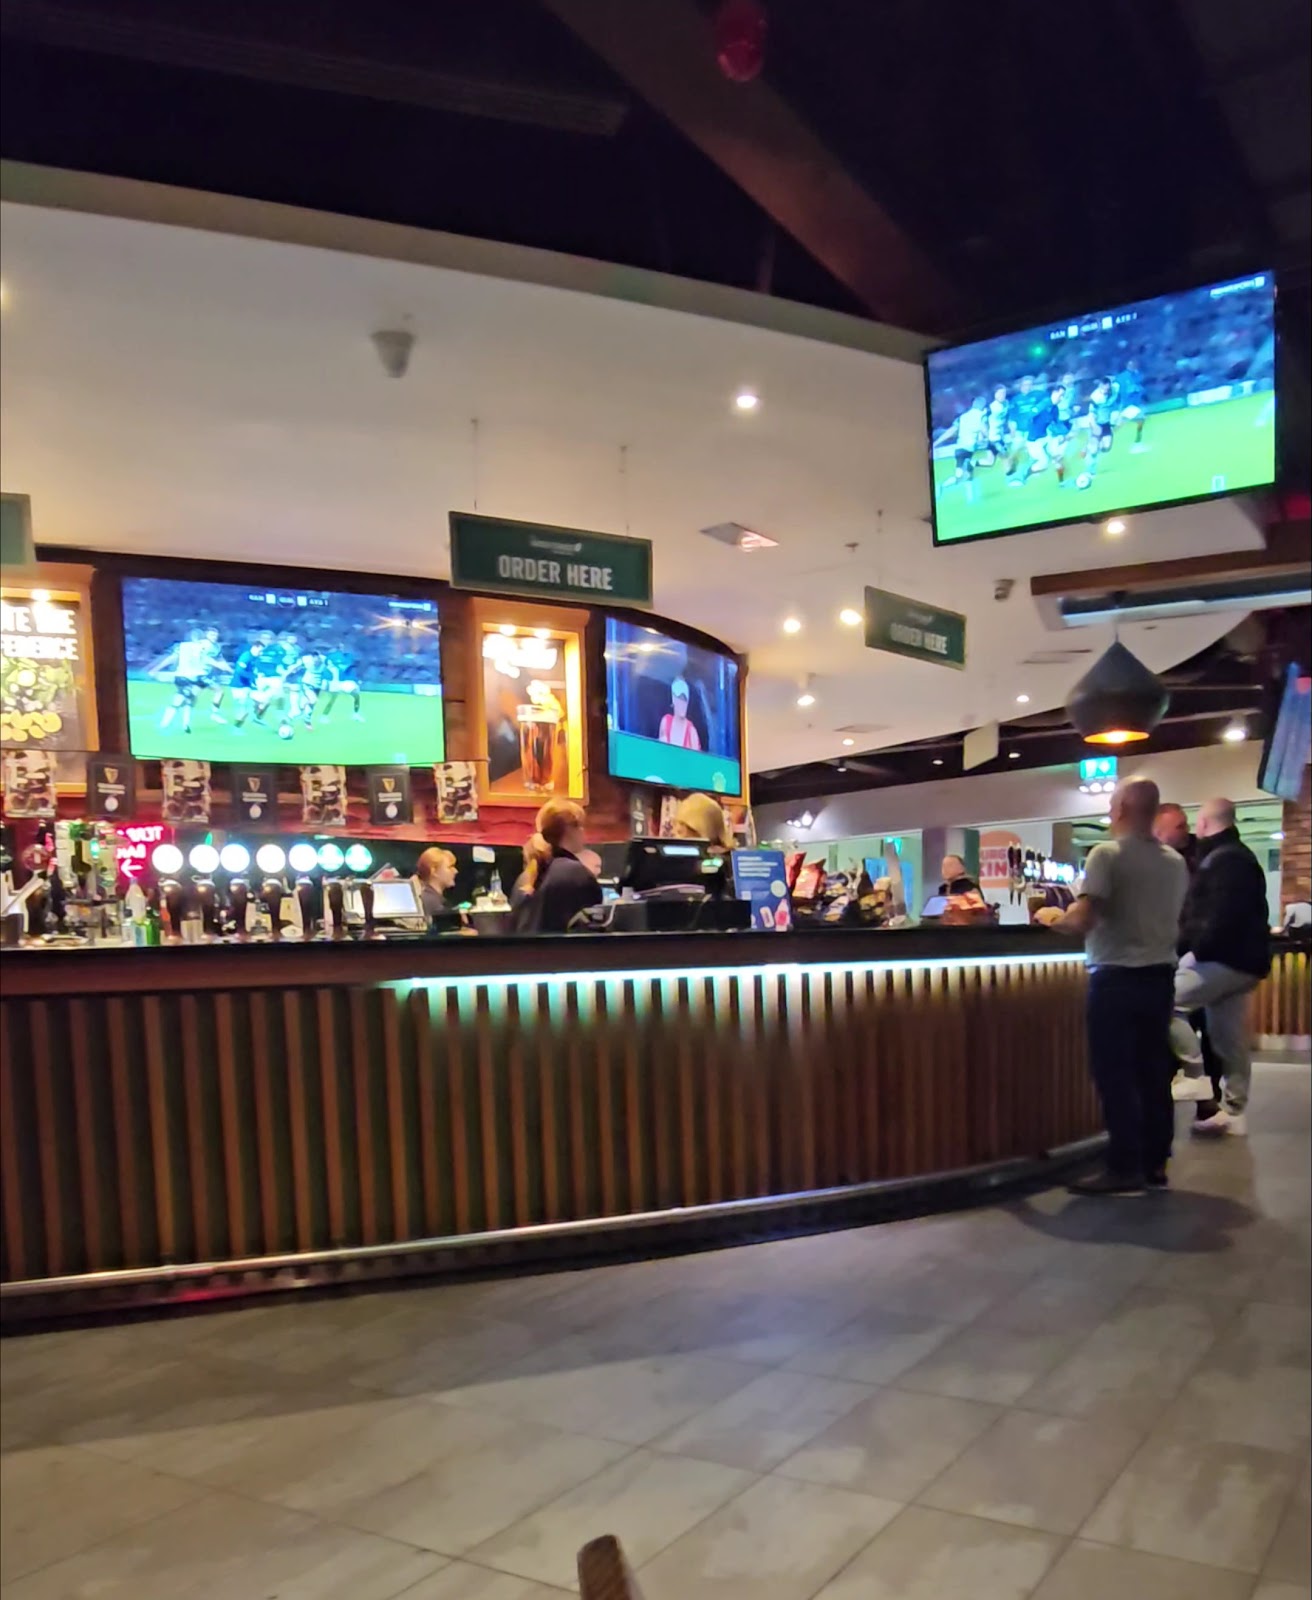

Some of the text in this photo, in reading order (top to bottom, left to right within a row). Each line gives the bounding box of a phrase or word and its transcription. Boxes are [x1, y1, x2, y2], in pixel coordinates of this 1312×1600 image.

[498, 554, 614, 590] ORDER HERE
[923, 631, 948, 655] HERE
